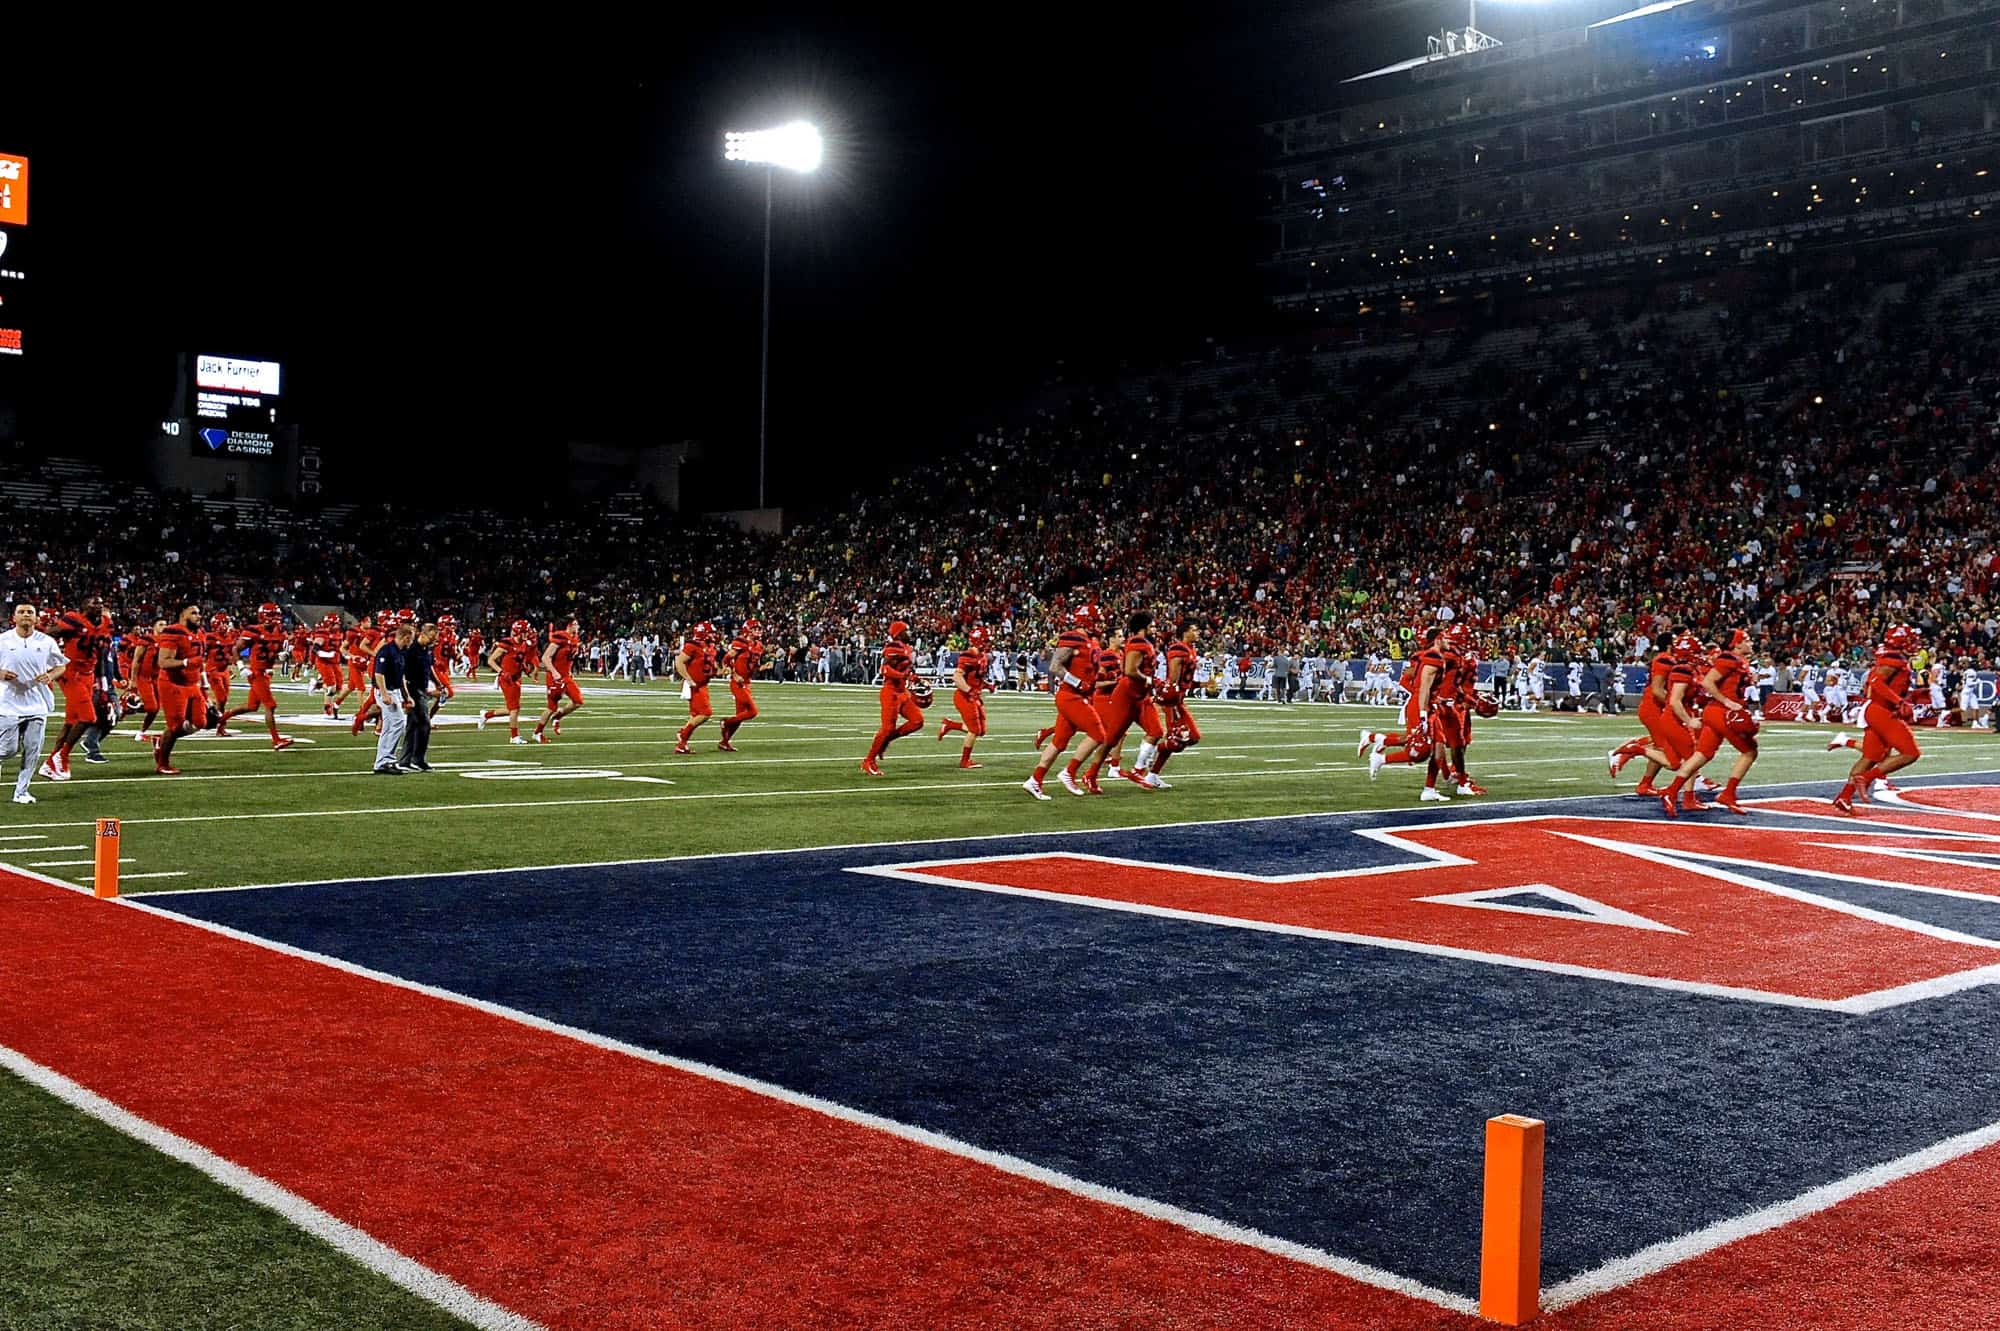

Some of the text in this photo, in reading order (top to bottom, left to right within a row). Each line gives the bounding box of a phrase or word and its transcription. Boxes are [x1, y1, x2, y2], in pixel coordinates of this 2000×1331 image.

[200, 360, 222, 373] Jack
[162, 421, 180, 436] 40
[231, 431, 270, 441] DESERT
[226, 438, 275, 449] DIAMOND
[227, 445, 273, 455] CASINOS
